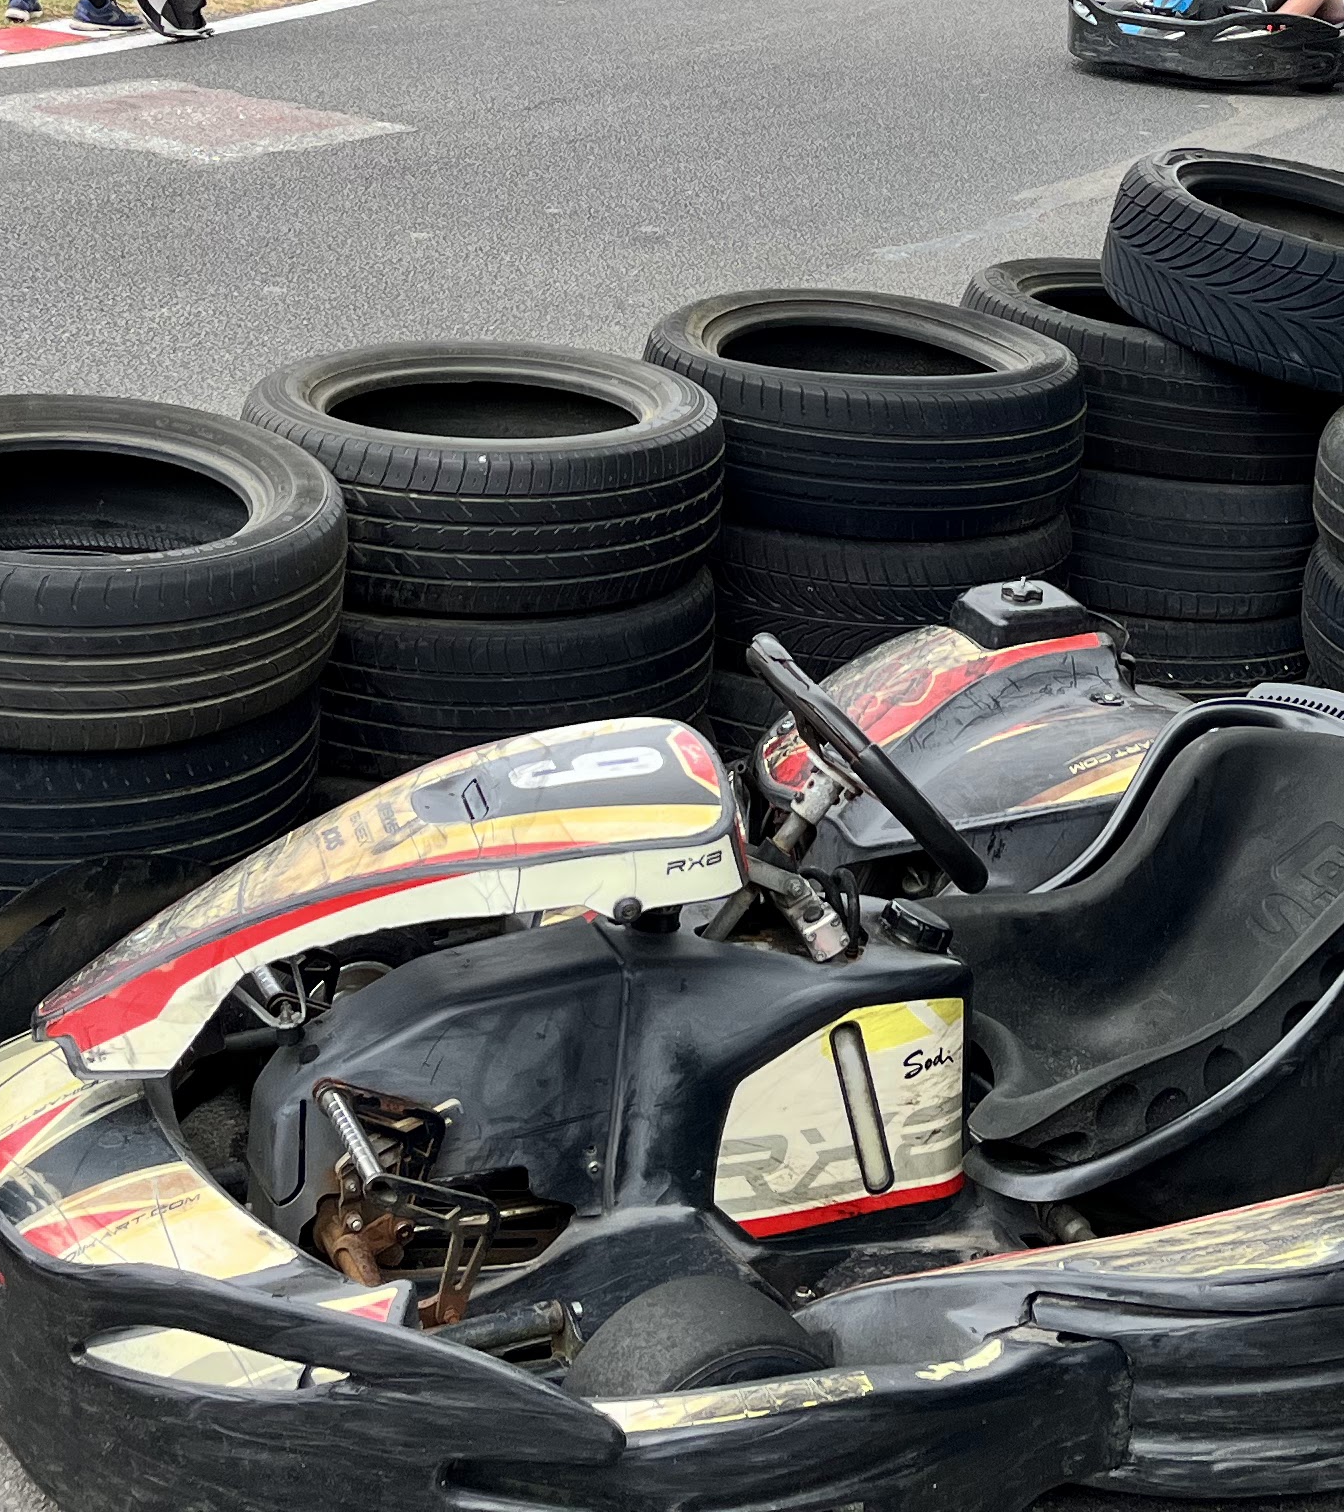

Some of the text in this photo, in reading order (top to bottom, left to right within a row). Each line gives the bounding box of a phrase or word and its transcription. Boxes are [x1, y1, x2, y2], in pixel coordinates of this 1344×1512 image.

[508, 745, 664, 790] 9
[666, 850, 722, 876] RX8
[903, 1048, 954, 1080] Sodi
